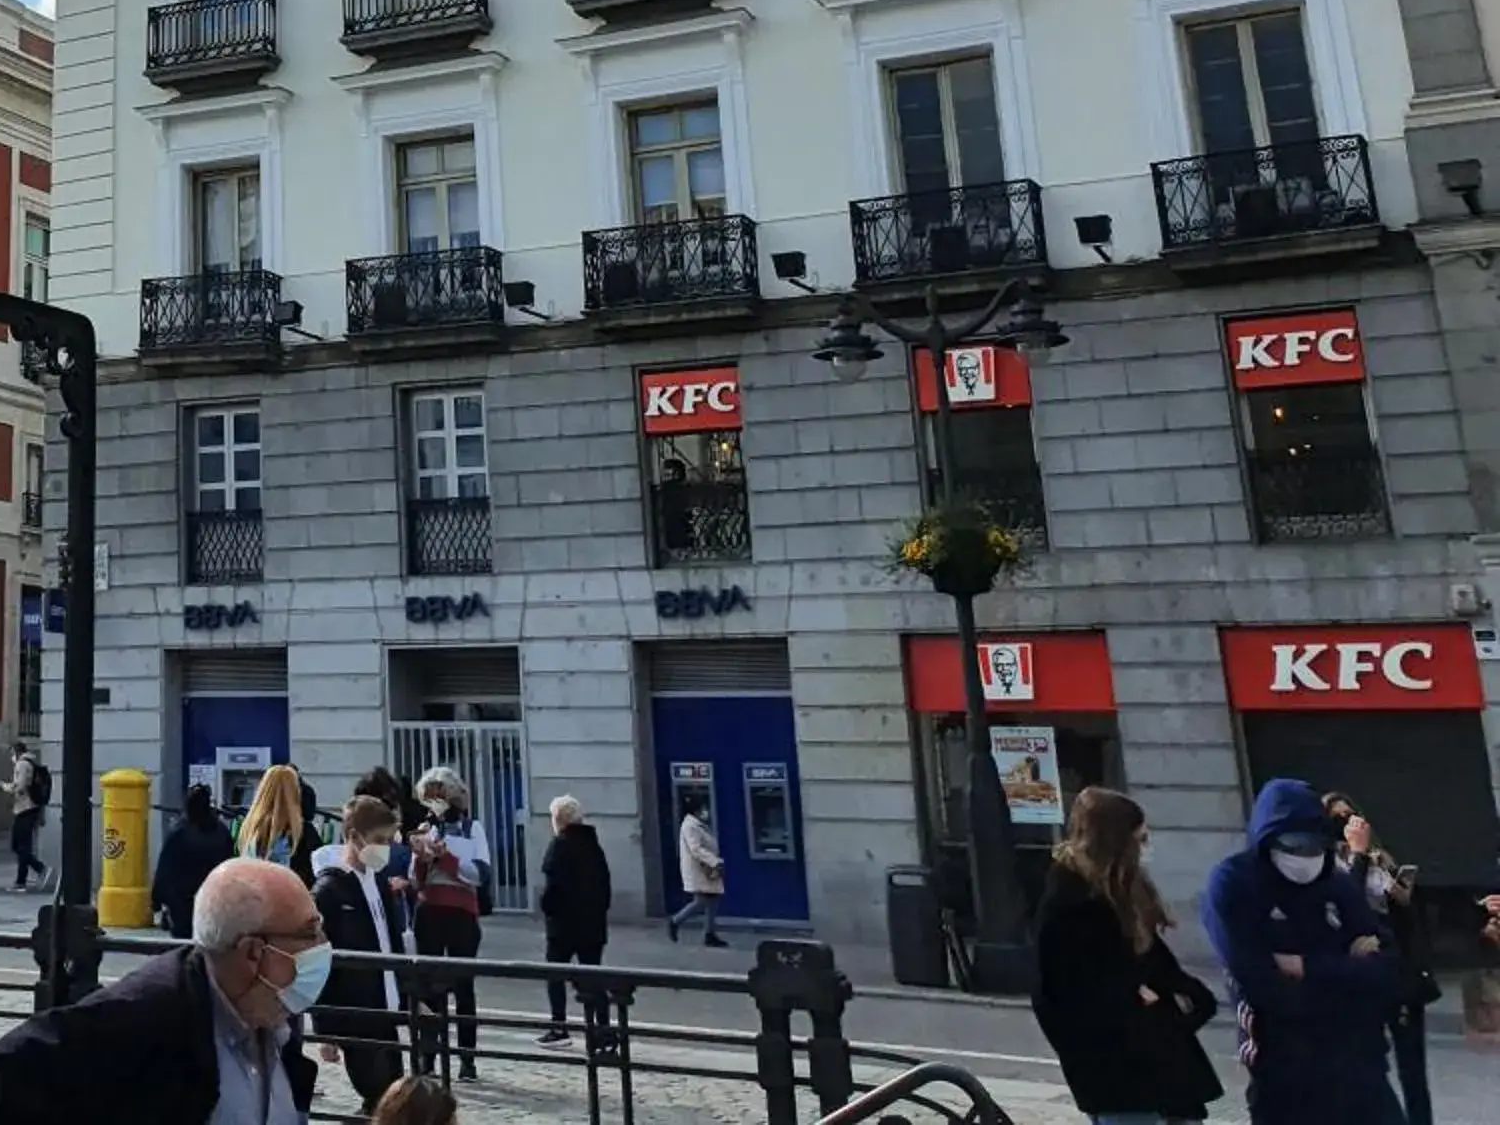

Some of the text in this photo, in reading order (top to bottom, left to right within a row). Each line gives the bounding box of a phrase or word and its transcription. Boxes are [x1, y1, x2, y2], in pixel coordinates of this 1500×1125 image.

[1235, 327, 1357, 371] KFC
[643, 380, 738, 419] KFC
[183, 599, 261, 631] BBVA
[404, 591, 491, 624] BBVA
[654, 584, 753, 619] BBVA
[1269, 640, 1433, 692] KFC
